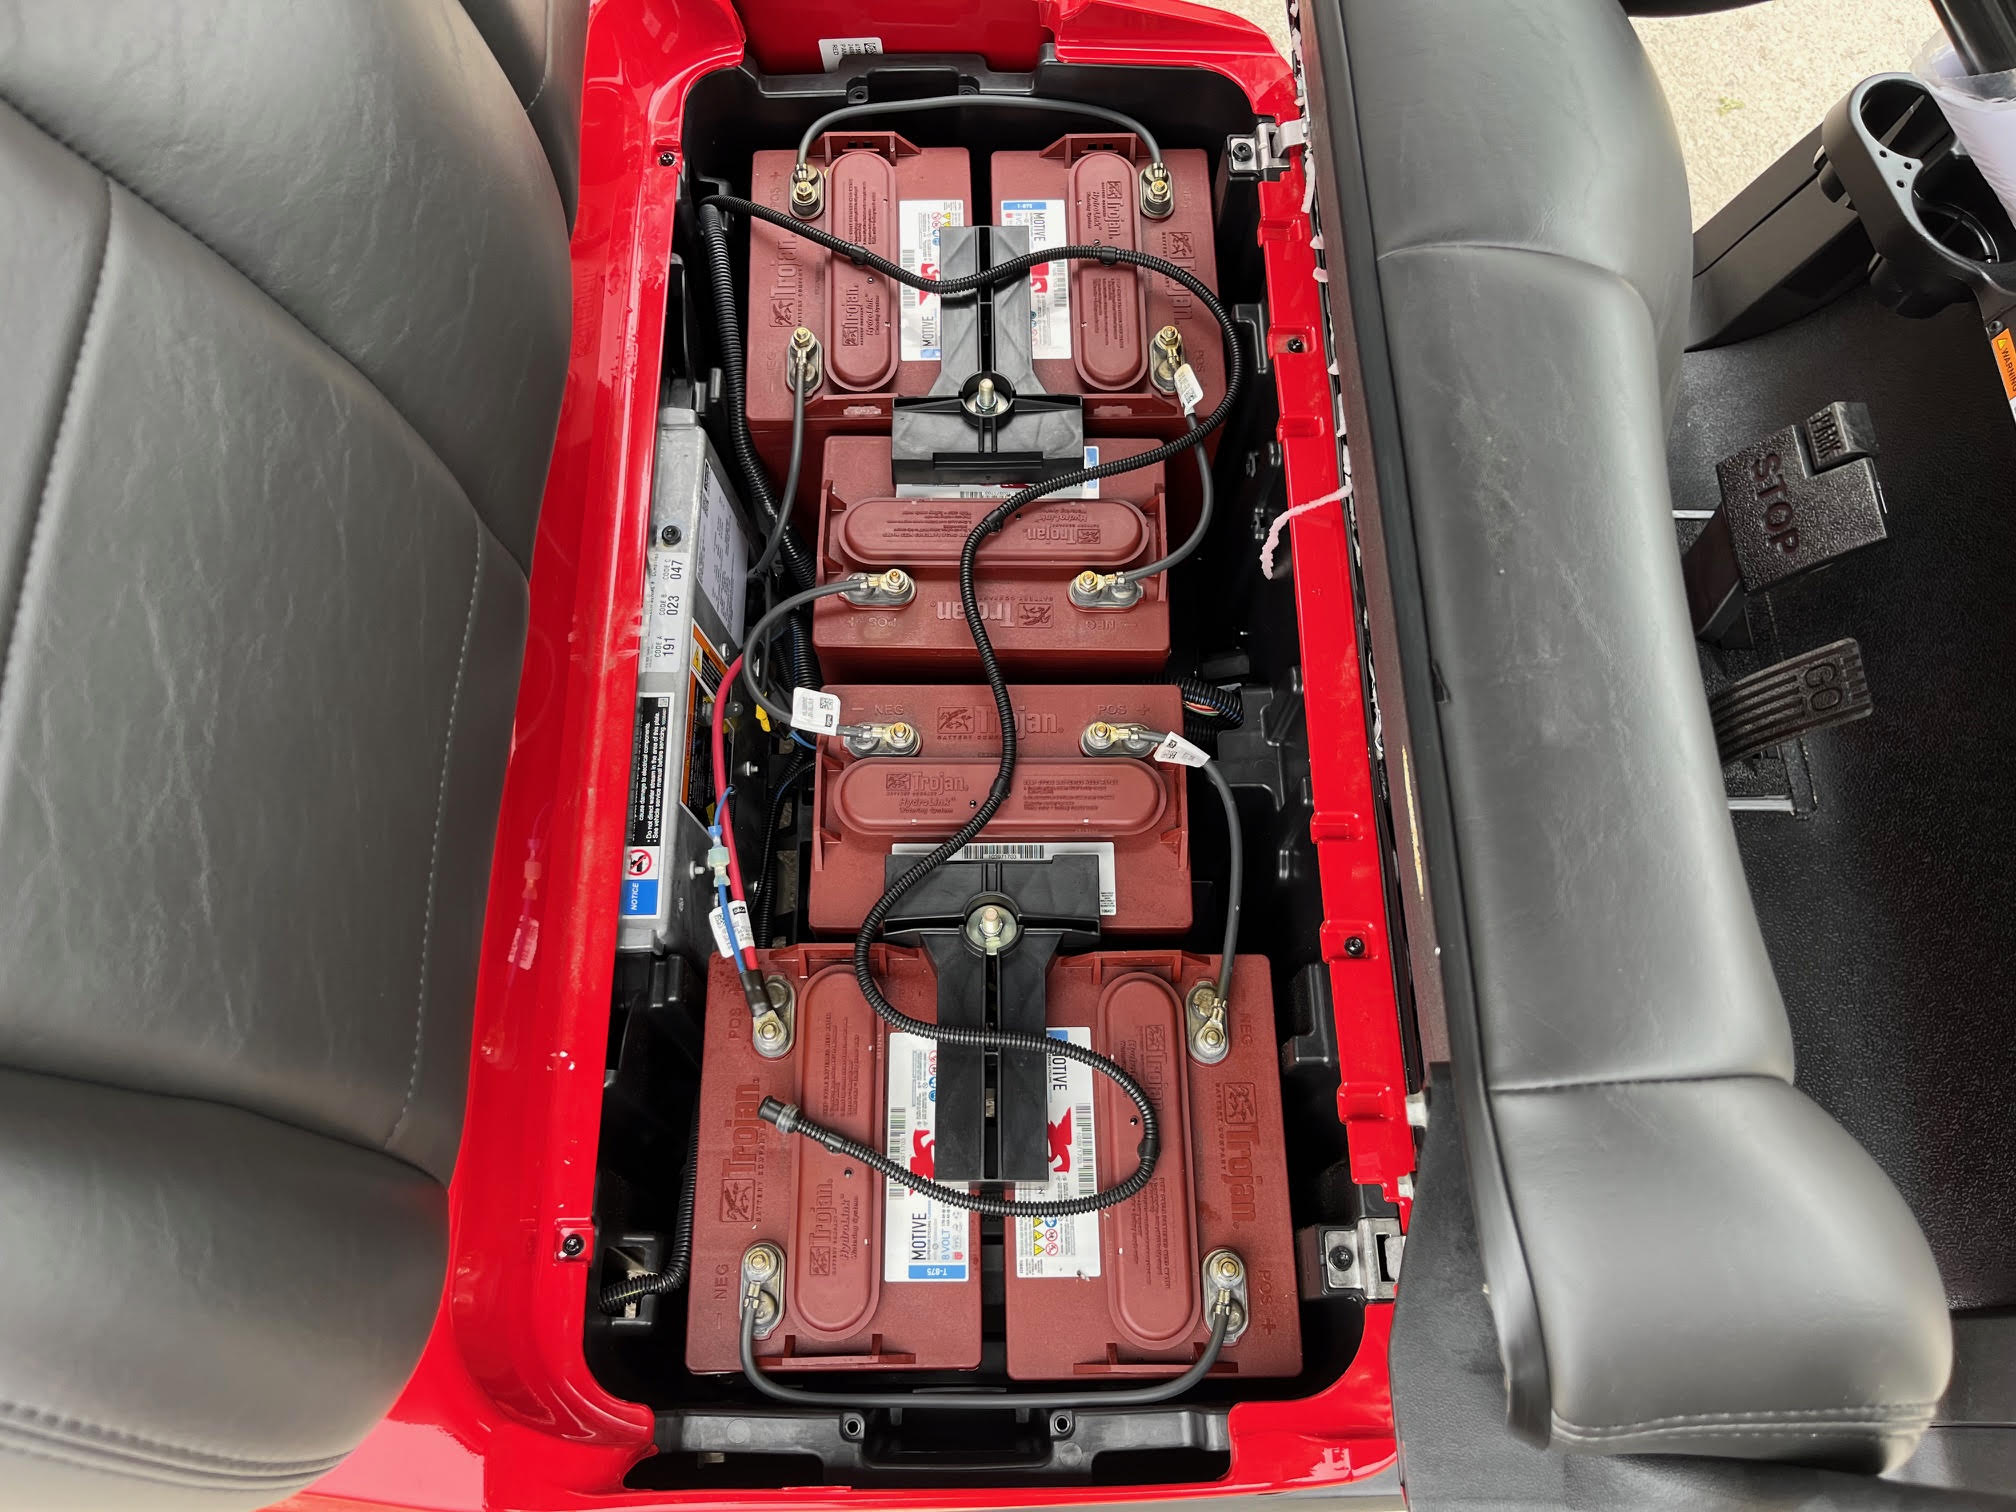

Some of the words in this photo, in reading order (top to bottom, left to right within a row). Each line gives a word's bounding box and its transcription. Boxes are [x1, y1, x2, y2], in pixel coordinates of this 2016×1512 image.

[1034, 213, 1046, 241] MOTIVE
[1105, 200, 1124, 238] Trojan
[770, 240, 802, 298] Trojan
[1166, 258, 1196, 319] Tojan
[842, 288, 863, 327] Trojan
[922, 316, 934, 346] MOTIVE
[2002, 348, 2016, 392] WARNING
[1809, 414, 1843, 459] PARK
[1752, 453, 1801, 556] STOP
[1027, 524, 1076, 545] Trojan
[670, 560, 683, 580] 047
[666, 595, 680, 616] 023
[937, 601, 1015, 628] Troan
[654, 641, 662, 657] CODE
[662, 638, 675, 656] 191
[1804, 661, 1842, 714] GO
[874, 704, 905, 715] NEG
[975, 705, 1057, 740] Trjan
[1097, 703, 1127, 715] POS
[912, 771, 965, 795] Trojan
[646, 831, 653, 839] Do
[630, 882, 639, 911] NOTICE
[727, 1008, 743, 1039] POS
[1240, 1013, 1253, 1046] NEG
[1142, 1053, 1168, 1111] Trojan
[722, 1084, 766, 1177] Trojan
[758, 1131, 766, 1175] COMPANY
[1220, 1123, 1263, 1221] Trojan
[809, 1183, 837, 1245] Trojan
[840, 1199, 850, 1260] HydroLink
[912, 1213, 926, 1260] MOTIVE
[941, 1230, 950, 1253] VOLT
[713, 1263, 729, 1300] NEG
[1258, 1269, 1274, 1305] POS
